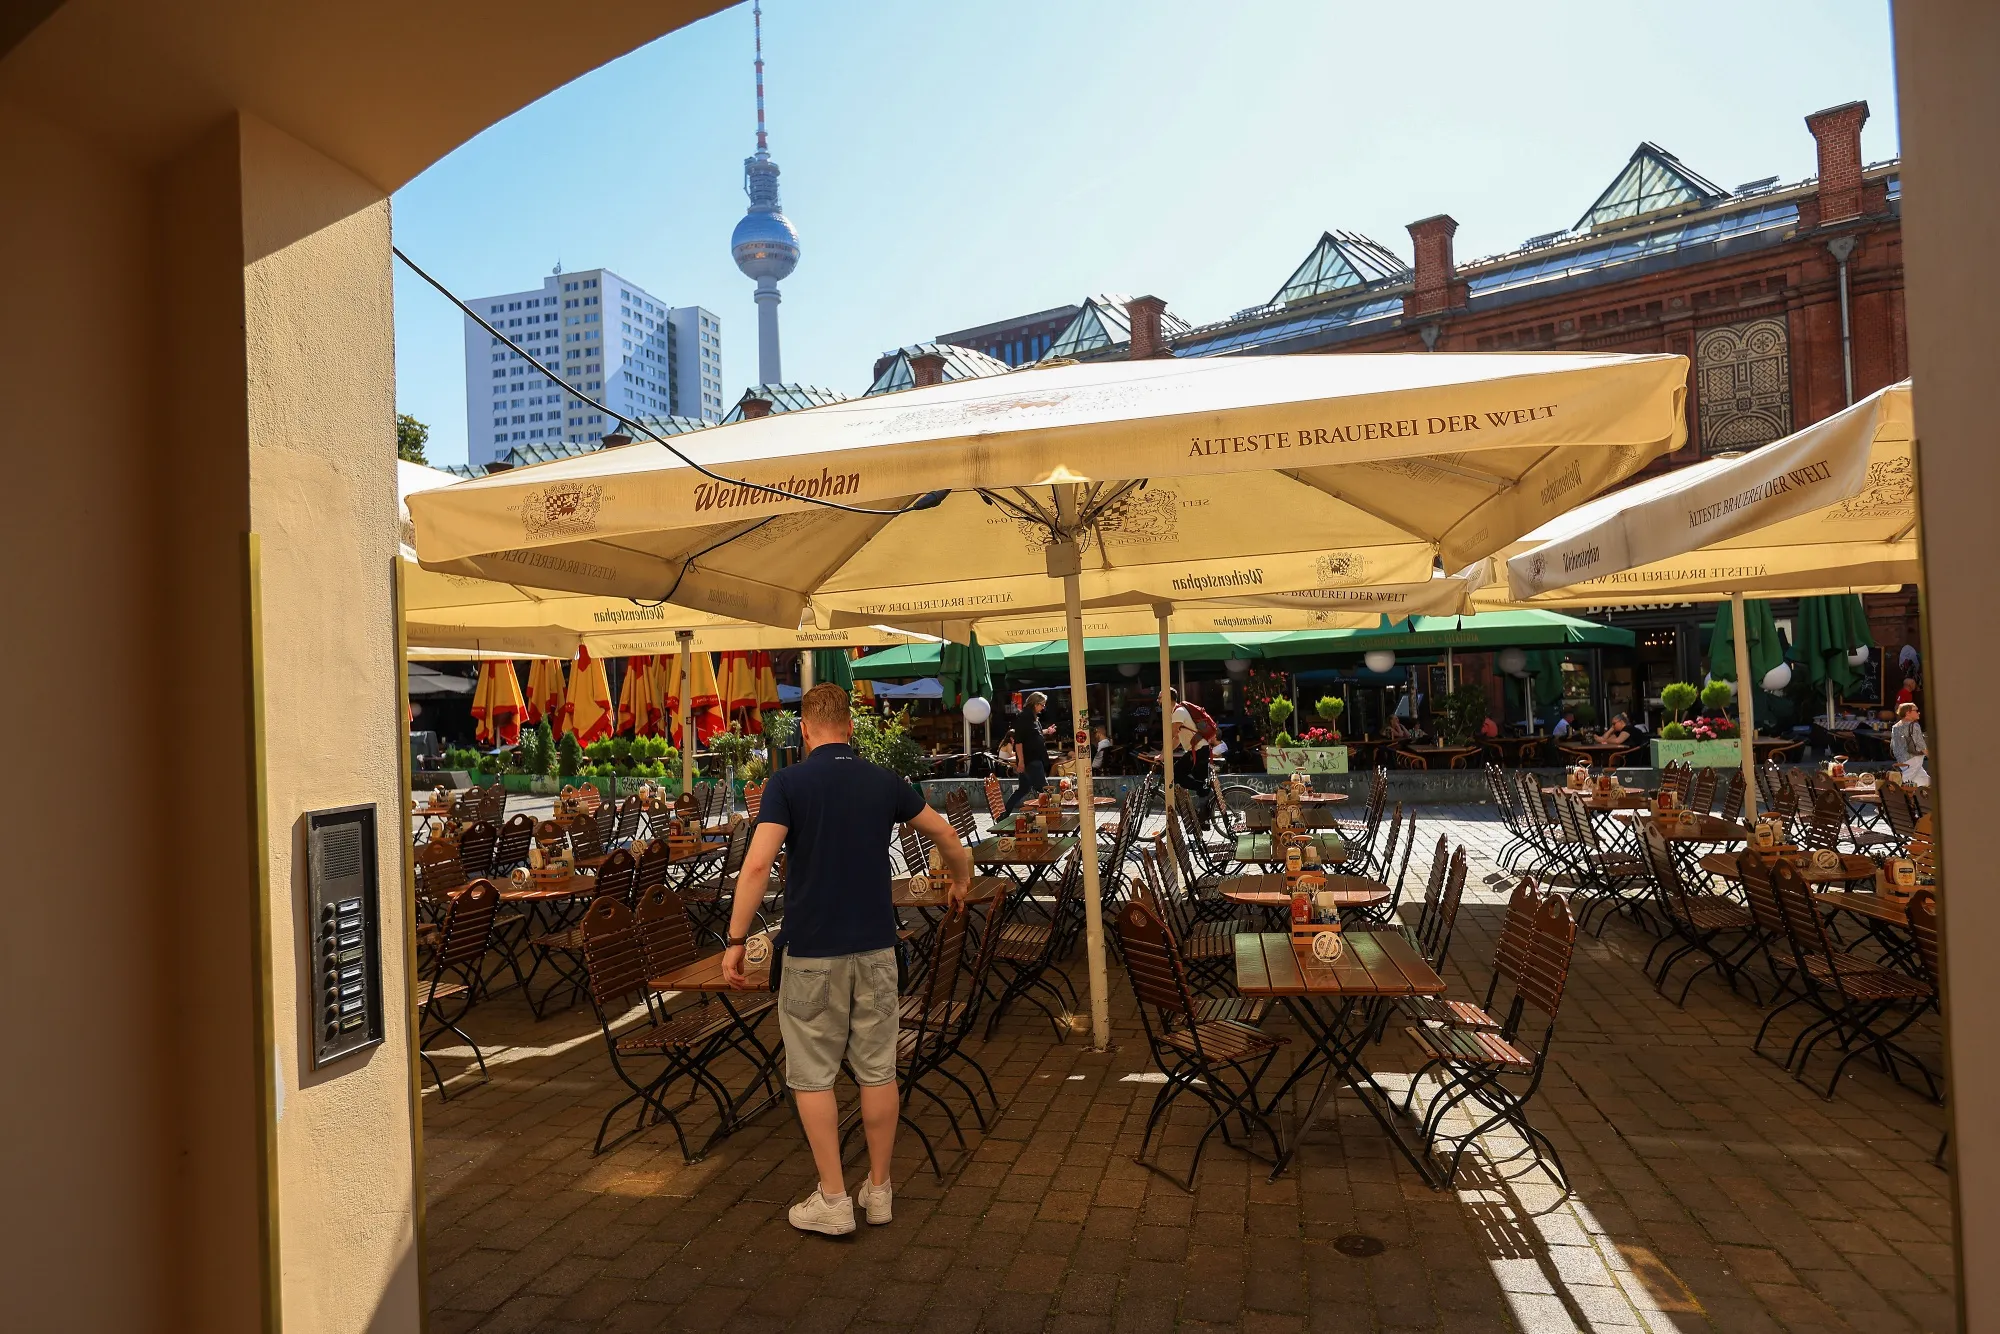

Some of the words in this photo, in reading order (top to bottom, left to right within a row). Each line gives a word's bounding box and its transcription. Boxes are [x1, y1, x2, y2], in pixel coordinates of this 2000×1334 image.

[1188, 432, 1291, 457] ÄLTESTE
[1297, 419, 1419, 447] BRAUEREI
[1427, 414, 1481, 435] DER
[1484, 404, 1558, 428] WELT
[693, 467, 860, 512] Weihenstephan
[1689, 502, 1722, 528] ÄLTESTE
[1723, 483, 1765, 515] BRAUEREI
[1765, 475, 1792, 498] DER
[1787, 460, 1832, 486] WELT
[1291, 589, 1346, 600] BRAUEREI
[1349, 590, 1373, 601] DER
[1376, 592, 1408, 602] WELT
